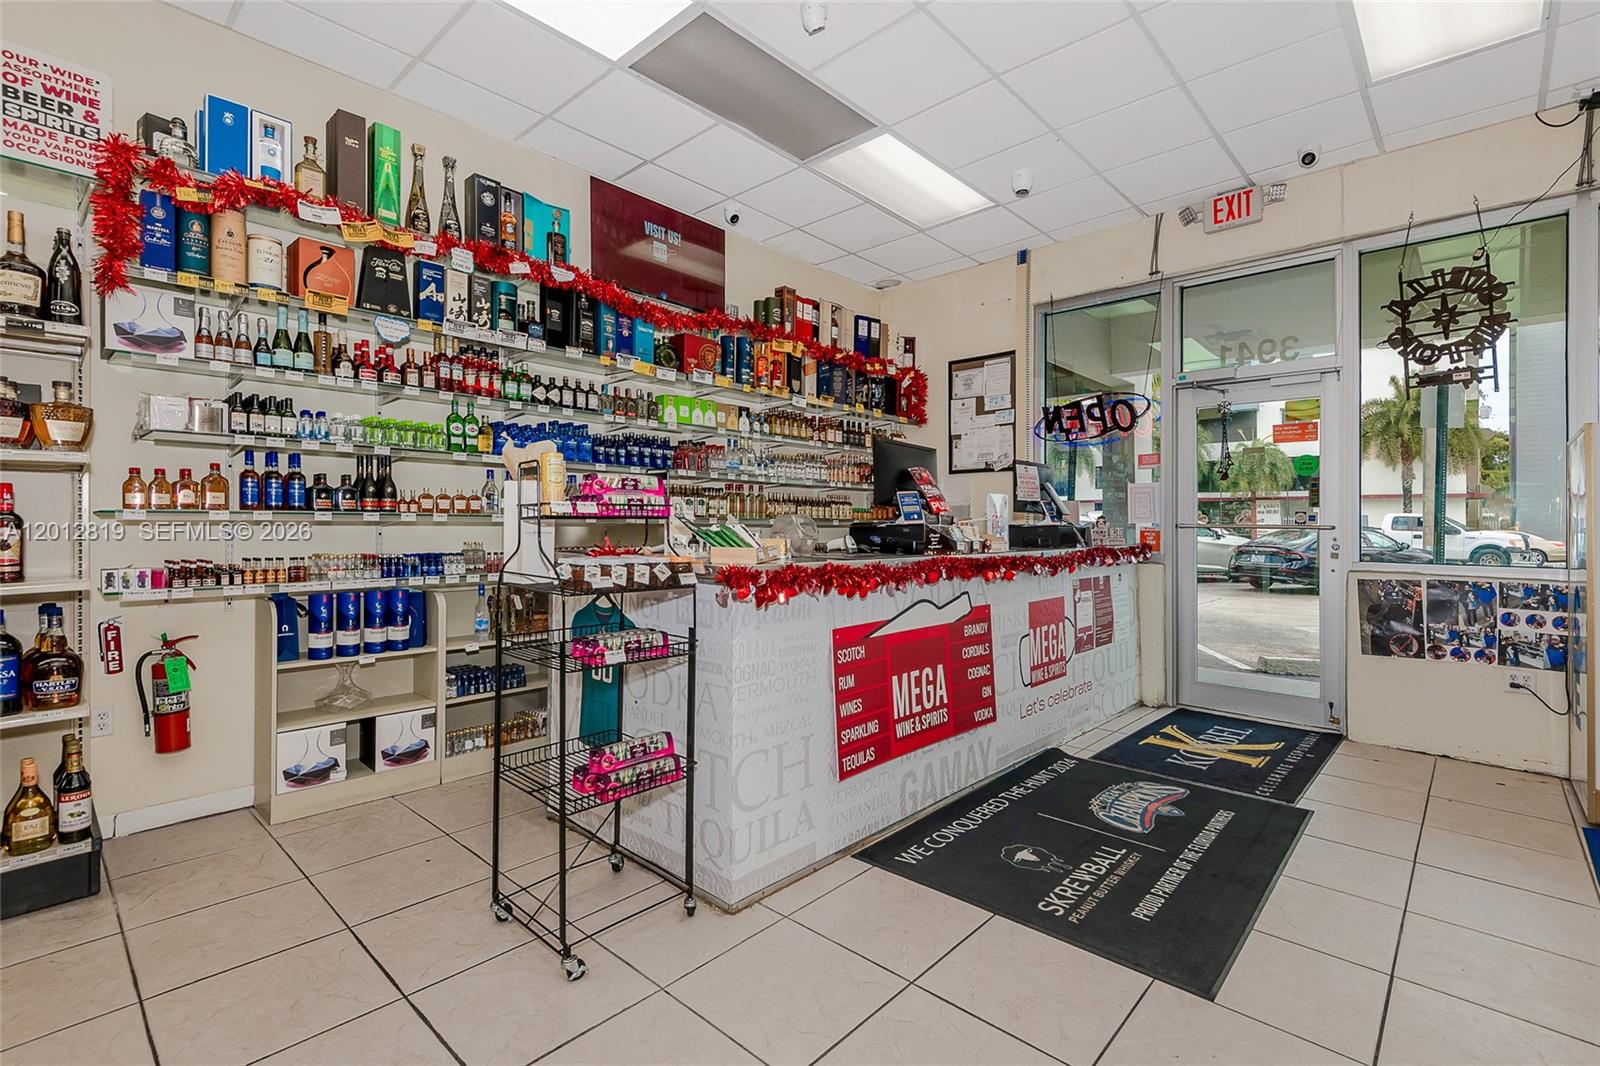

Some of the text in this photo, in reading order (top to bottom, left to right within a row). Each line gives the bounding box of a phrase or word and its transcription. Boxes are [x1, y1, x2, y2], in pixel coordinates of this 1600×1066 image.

[1, 50, 39, 68] OUR
[2, 61, 100, 97] ASSORTMENT
[2, 71, 101, 111] OF WINE
[2, 83, 99, 125] BEER &
[3, 101, 100, 140] SPIRITS
[3, 118, 100, 152] MADE FOR
[3, 129, 100, 162] YOUR VARIOUS
[3, 139, 97, 170] OCCASIONS
[1213, 189, 1254, 225] EXIT
[644, 220, 681, 246] VISIT US!
[0, 280, 31, 289] ennessy
[963, 622, 989, 637] BRANDY
[1030, 622, 1066, 667] MEGA
[107, 631, 120, 671] FIRE
[837, 645, 866, 664] SCOTCH
[962, 643, 990, 660] CORDIALS
[725, 659, 776, 684] COGNAC
[838, 674, 855, 691] RUM
[967, 664, 991, 680] COGNAC
[891, 664, 948, 720] MEGA
[981, 685, 992, 698] GIN
[1019, 679, 1093, 719] Let's celebrate
[839, 698, 863, 718] WINES
[895, 708, 949, 739] WINE & SPIRITS
[973, 707, 994, 723] VODKA
[841, 719, 879, 745] SPARKLING
[842, 747, 876, 772] TEQUILAS
[1255, 763, 1294, 796] CELEBRATE
[894, 757, 1080, 865] WE CONQUERED THE HUNT 2024
[1038, 845, 1127, 917] SKREWBALL
[1130, 808, 1236, 922] PROUD PARTNER OF THE FLORIDA PANTHERS
[1068, 852, 1142, 925] PEANUT BUTTER WHISKEY
